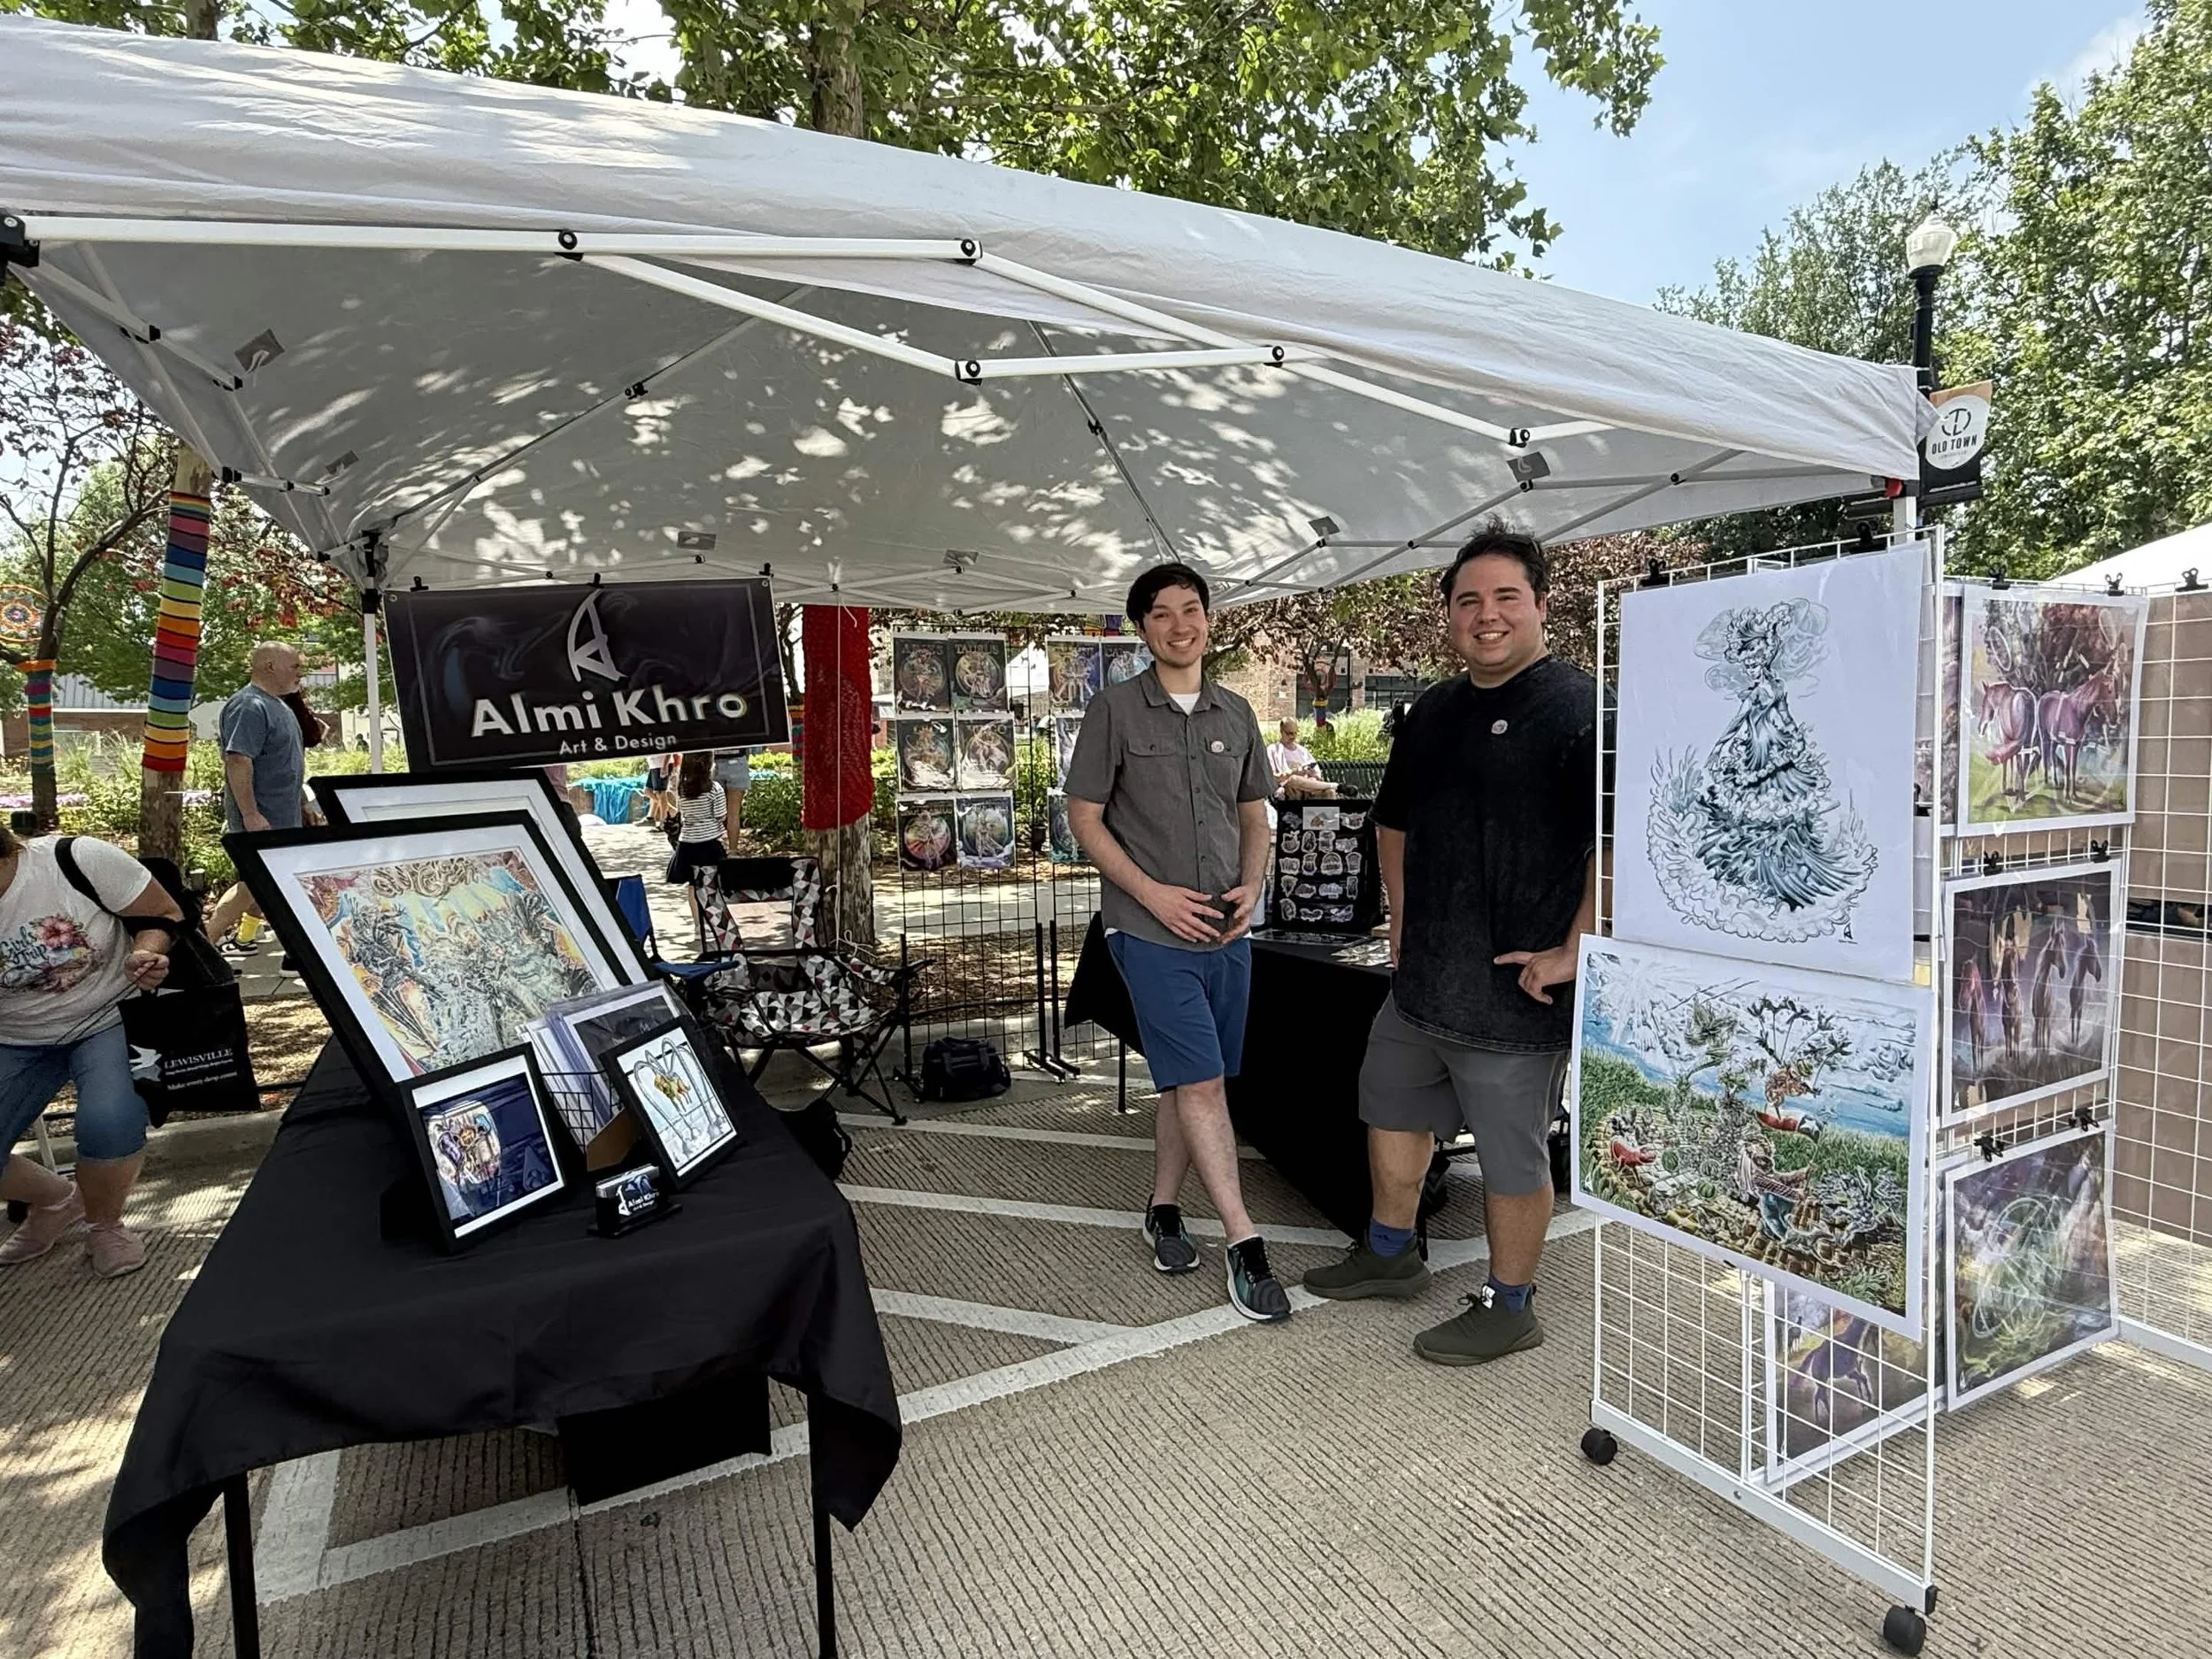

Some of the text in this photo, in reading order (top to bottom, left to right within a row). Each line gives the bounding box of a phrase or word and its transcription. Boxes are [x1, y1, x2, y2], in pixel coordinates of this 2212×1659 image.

[1932, 434, 1978, 454] OLD TOWN
[471, 684, 748, 738] Almi Khro
[558, 733, 677, 756] Art & Design
[165, 1048, 234, 1069] LEWISVILLE
